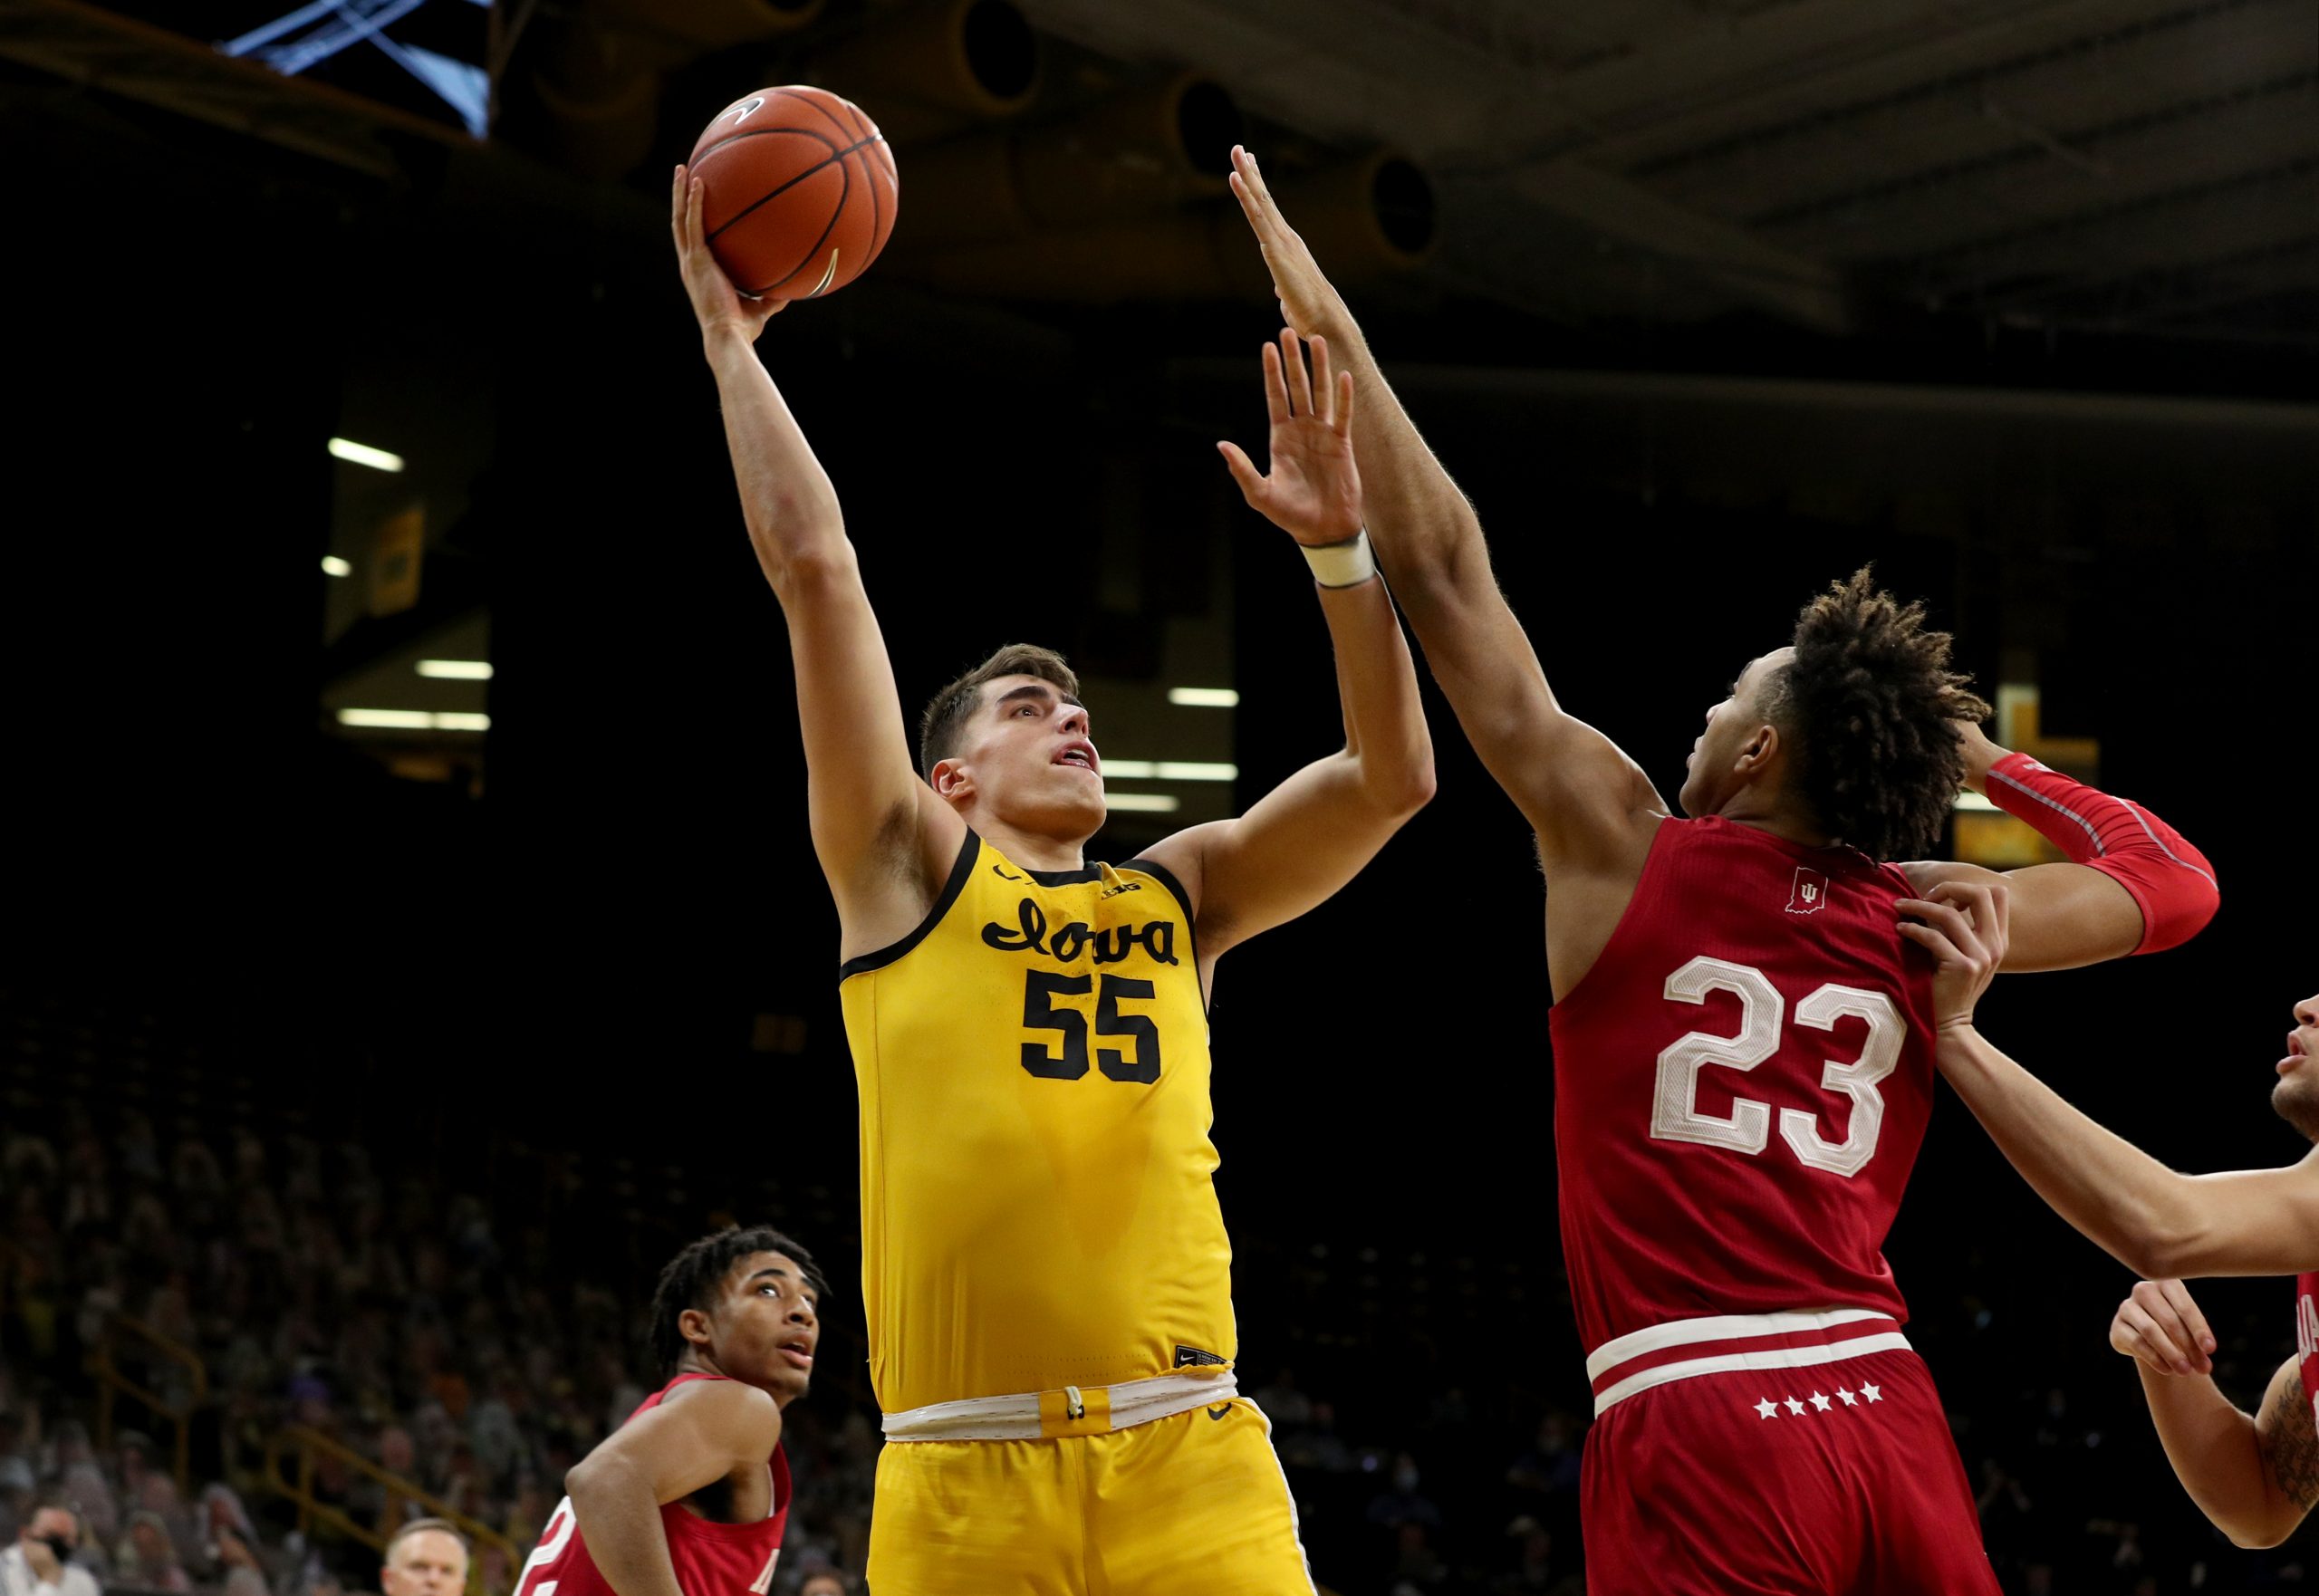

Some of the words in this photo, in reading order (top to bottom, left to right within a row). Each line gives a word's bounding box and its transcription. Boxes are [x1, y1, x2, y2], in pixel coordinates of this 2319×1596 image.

[981, 898, 1179, 966] Iowa
[1021, 969, 1161, 1084] 55
[1650, 956, 1908, 1178] 23
